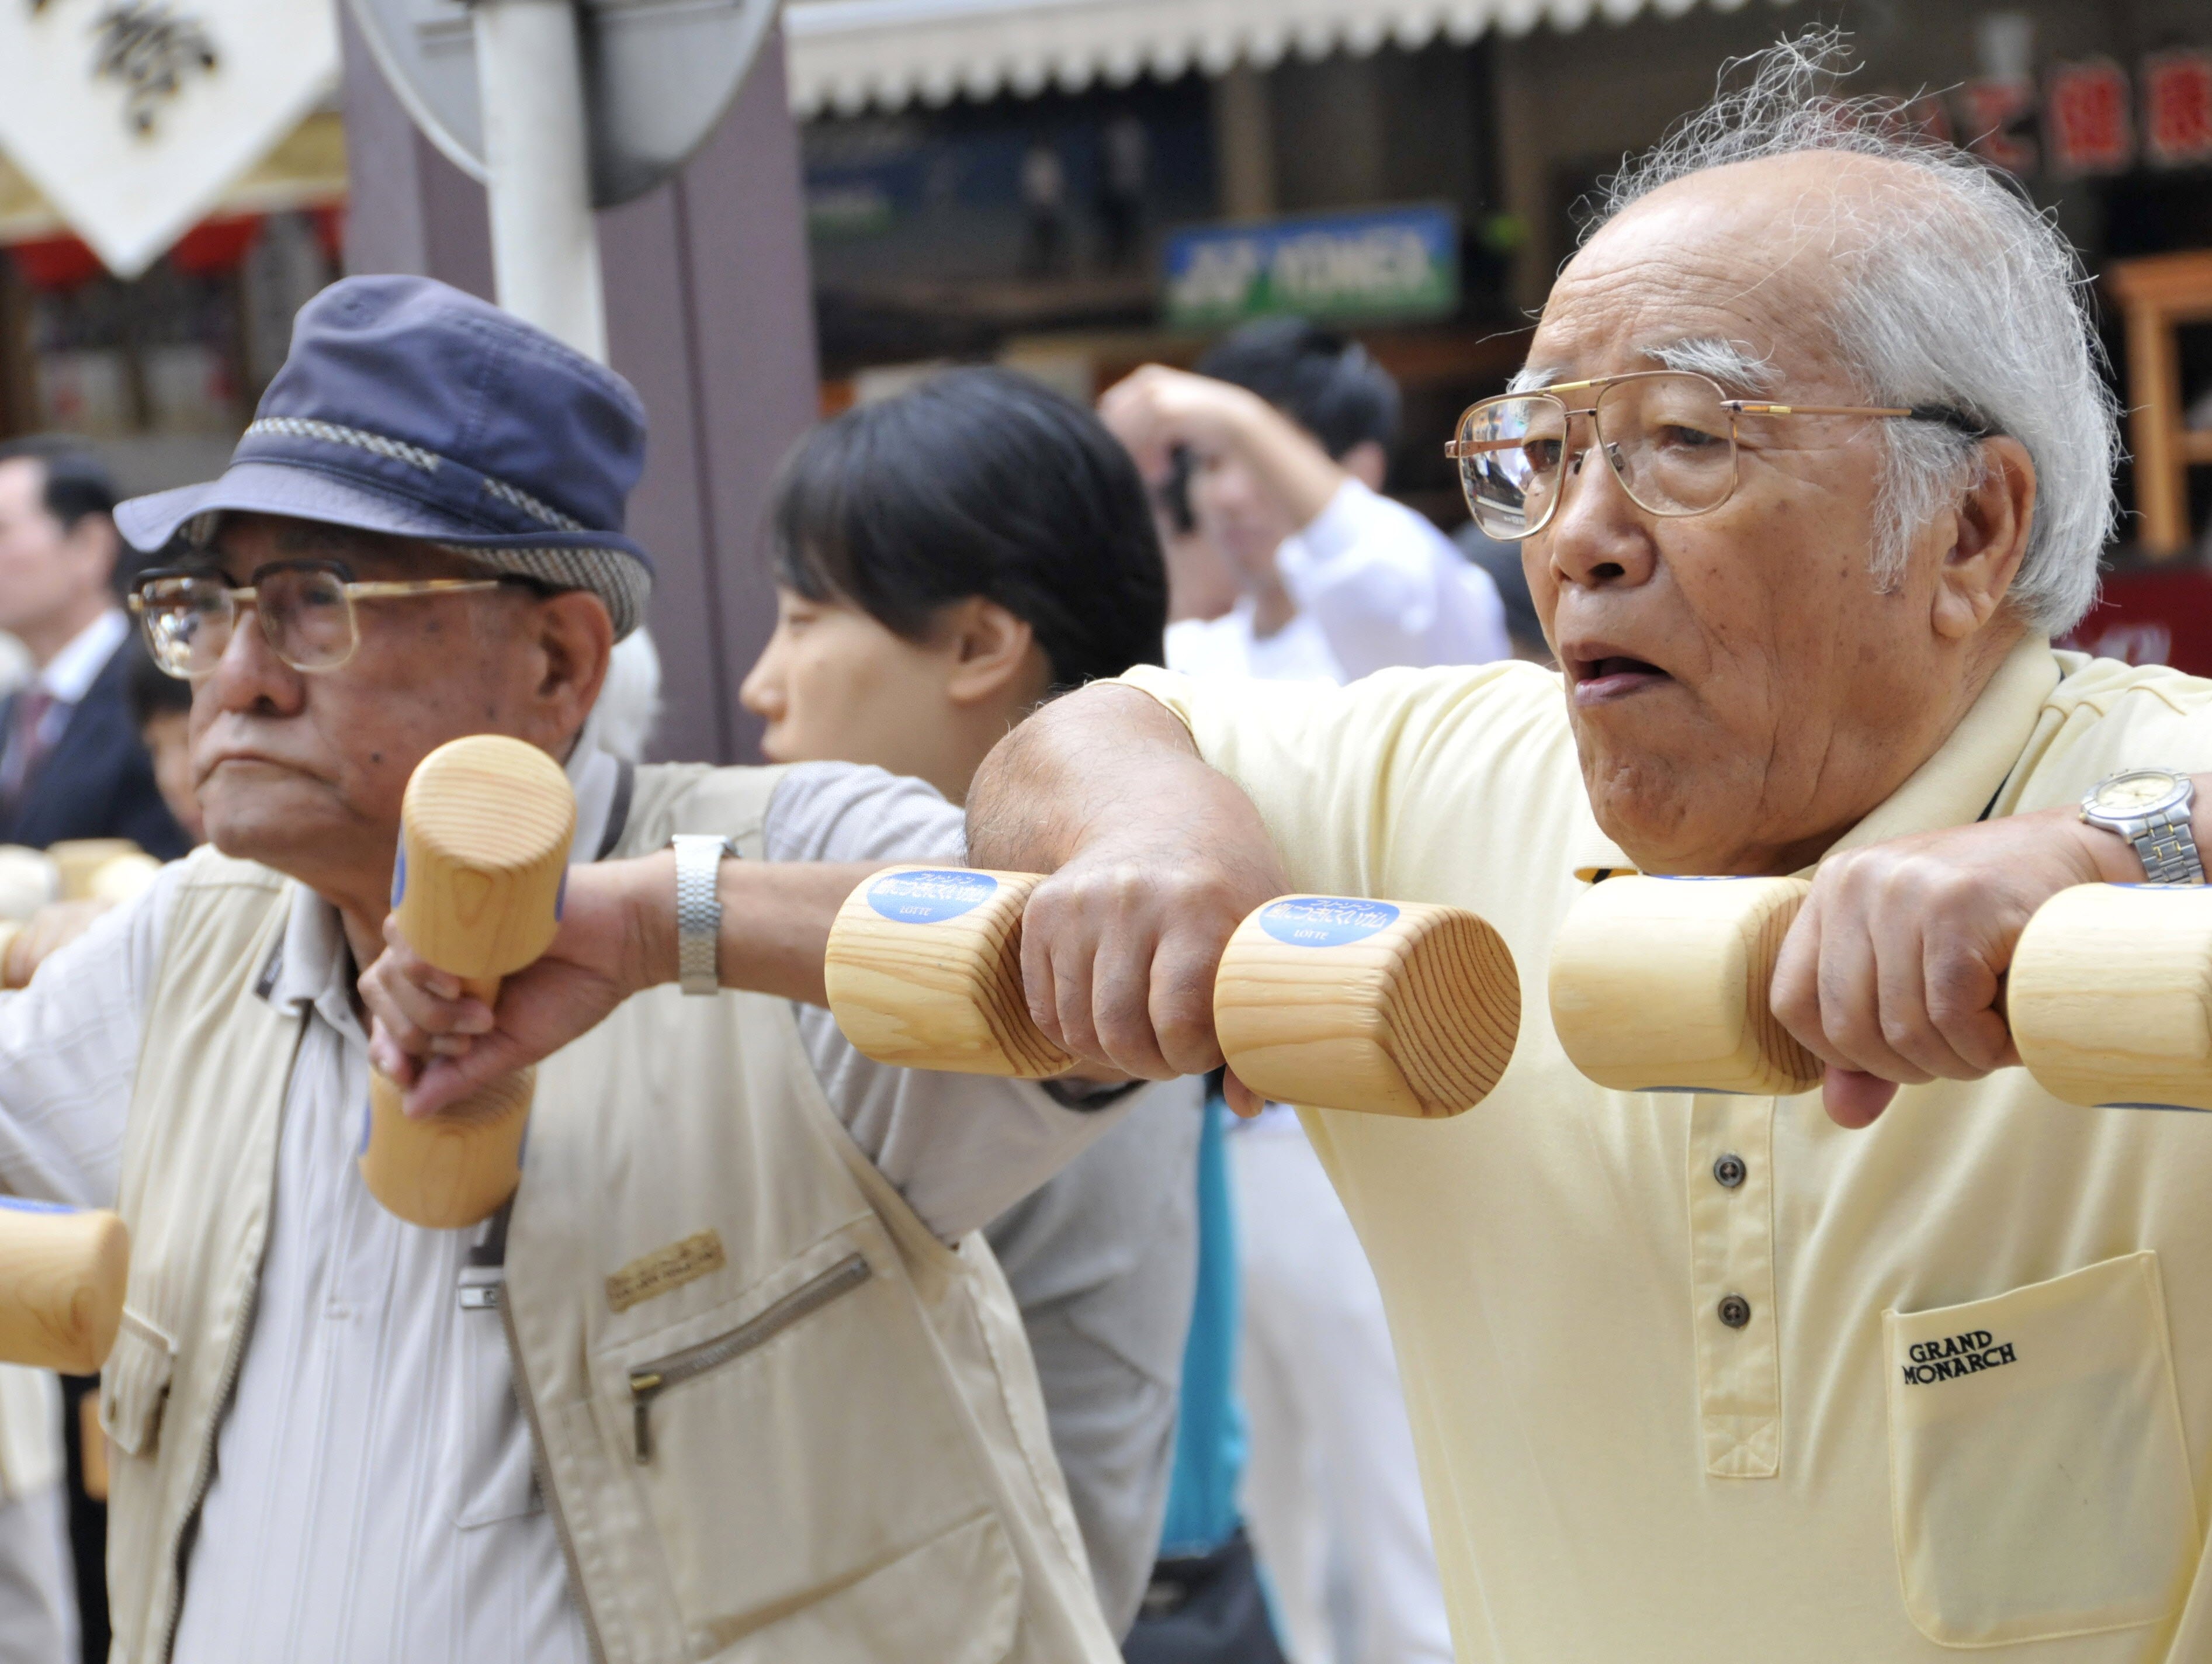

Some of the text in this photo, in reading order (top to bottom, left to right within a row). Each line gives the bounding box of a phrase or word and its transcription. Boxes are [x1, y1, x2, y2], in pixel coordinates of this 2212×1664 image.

[1293, 928, 1330, 941] LOTTE
[1909, 1330, 1992, 1363] GRAND
[1902, 1343, 2017, 1385] MONARCH
